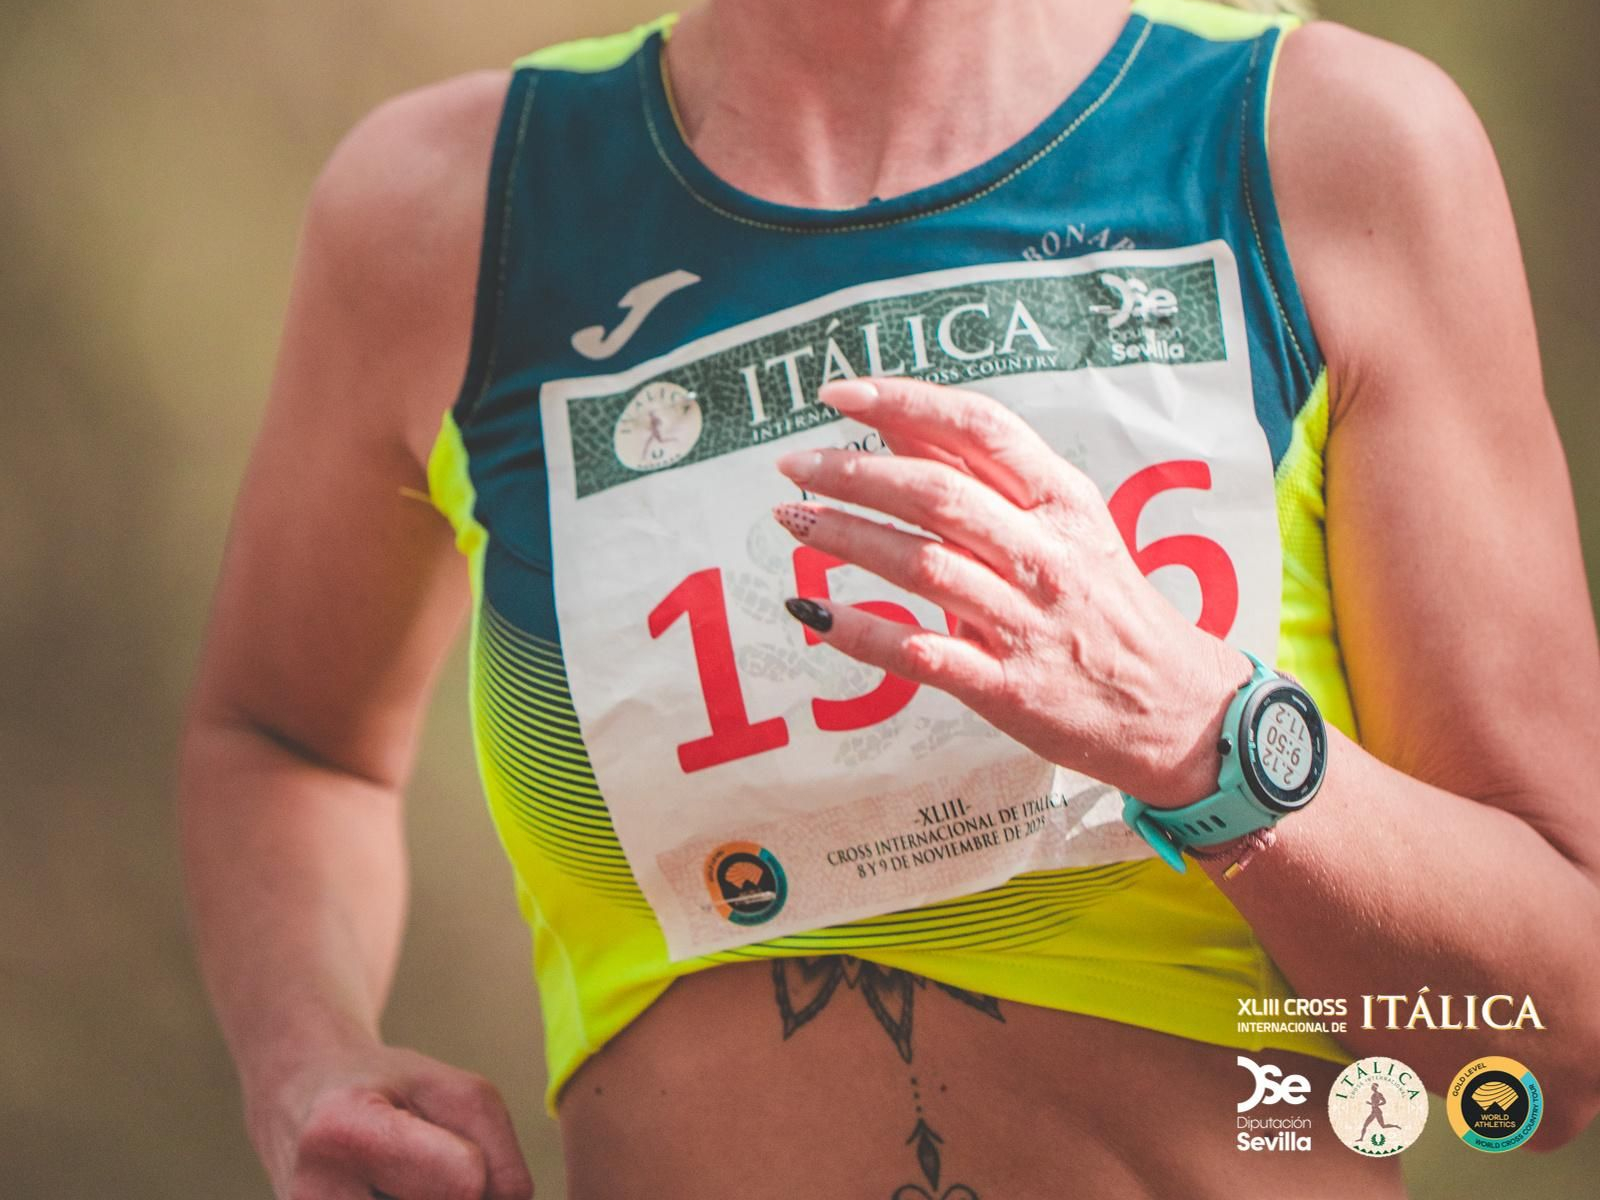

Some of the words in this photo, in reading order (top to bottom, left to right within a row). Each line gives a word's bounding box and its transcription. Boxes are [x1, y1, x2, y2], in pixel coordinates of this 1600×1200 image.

[740, 299, 1057, 427] ITÁLICA
[967, 355, 1058, 378] COUNTRY
[1111, 340, 1184, 362] Sevilla
[647, 460, 1238, 774] 156
[827, 842, 873, 867] CROSS
[876, 813, 996, 856] INTERNACIONAL
[998, 806, 1019, 824] DE
[857, 863, 867, 879] 8
[867, 861, 877, 877] Y
[879, 859, 888, 873] 9
[891, 854, 909, 872] DE
[912, 830, 1000, 867] NOVIEMBRE
[1003, 824, 1021, 843] DE
[1025, 815, 1045, 838] 2025
